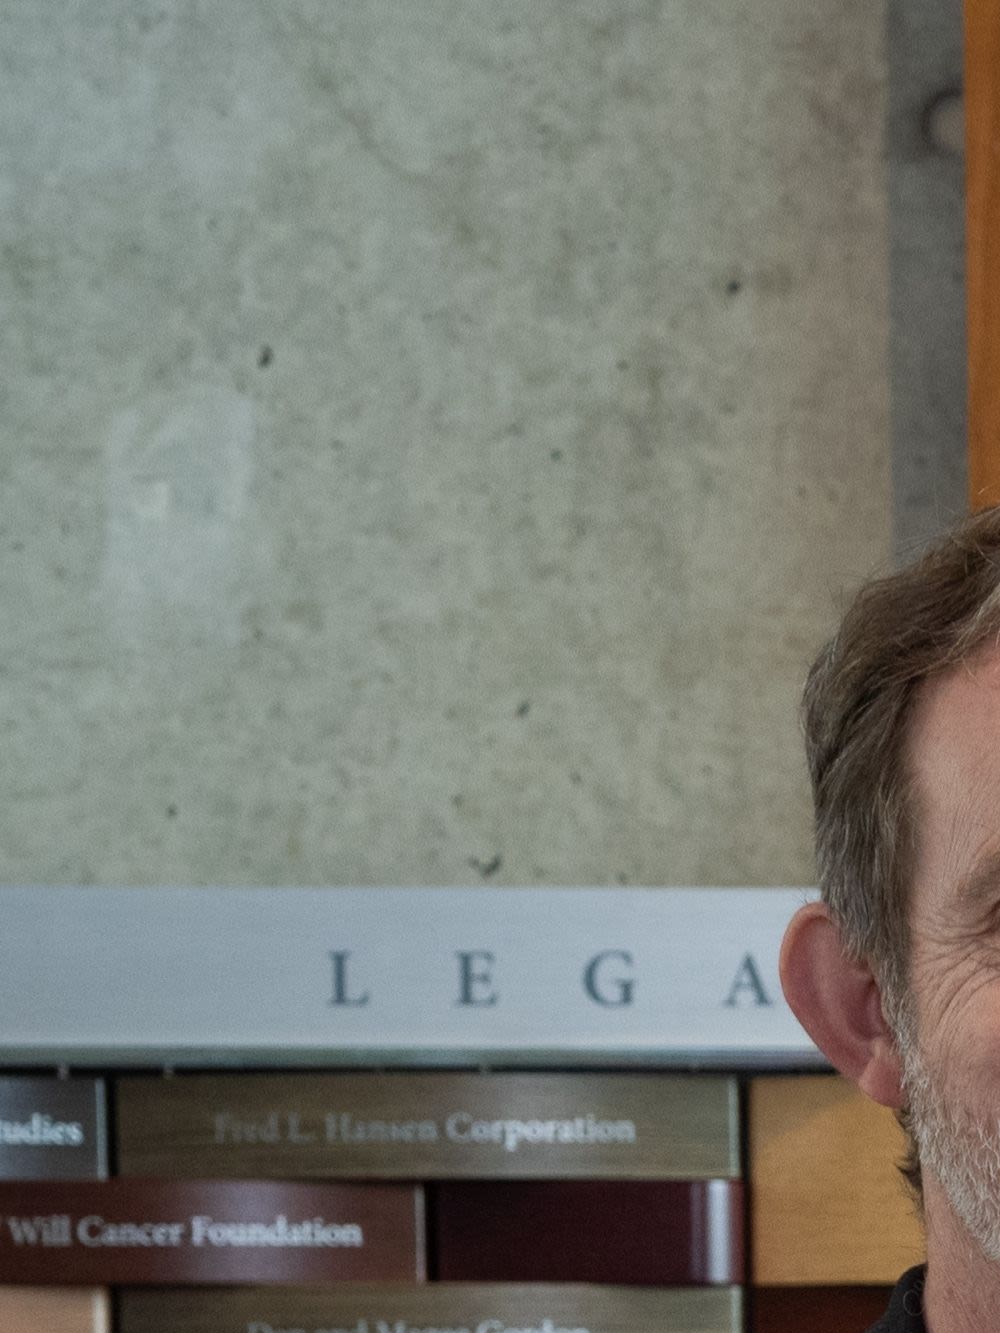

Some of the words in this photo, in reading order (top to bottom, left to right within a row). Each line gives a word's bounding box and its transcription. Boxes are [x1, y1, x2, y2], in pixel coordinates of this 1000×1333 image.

[446, 1111, 638, 1153] Corporation
[6, 1215, 71, 1248] Will
[78, 1215, 184, 1248] Cancer
[192, 1215, 364, 1248] Foundation
